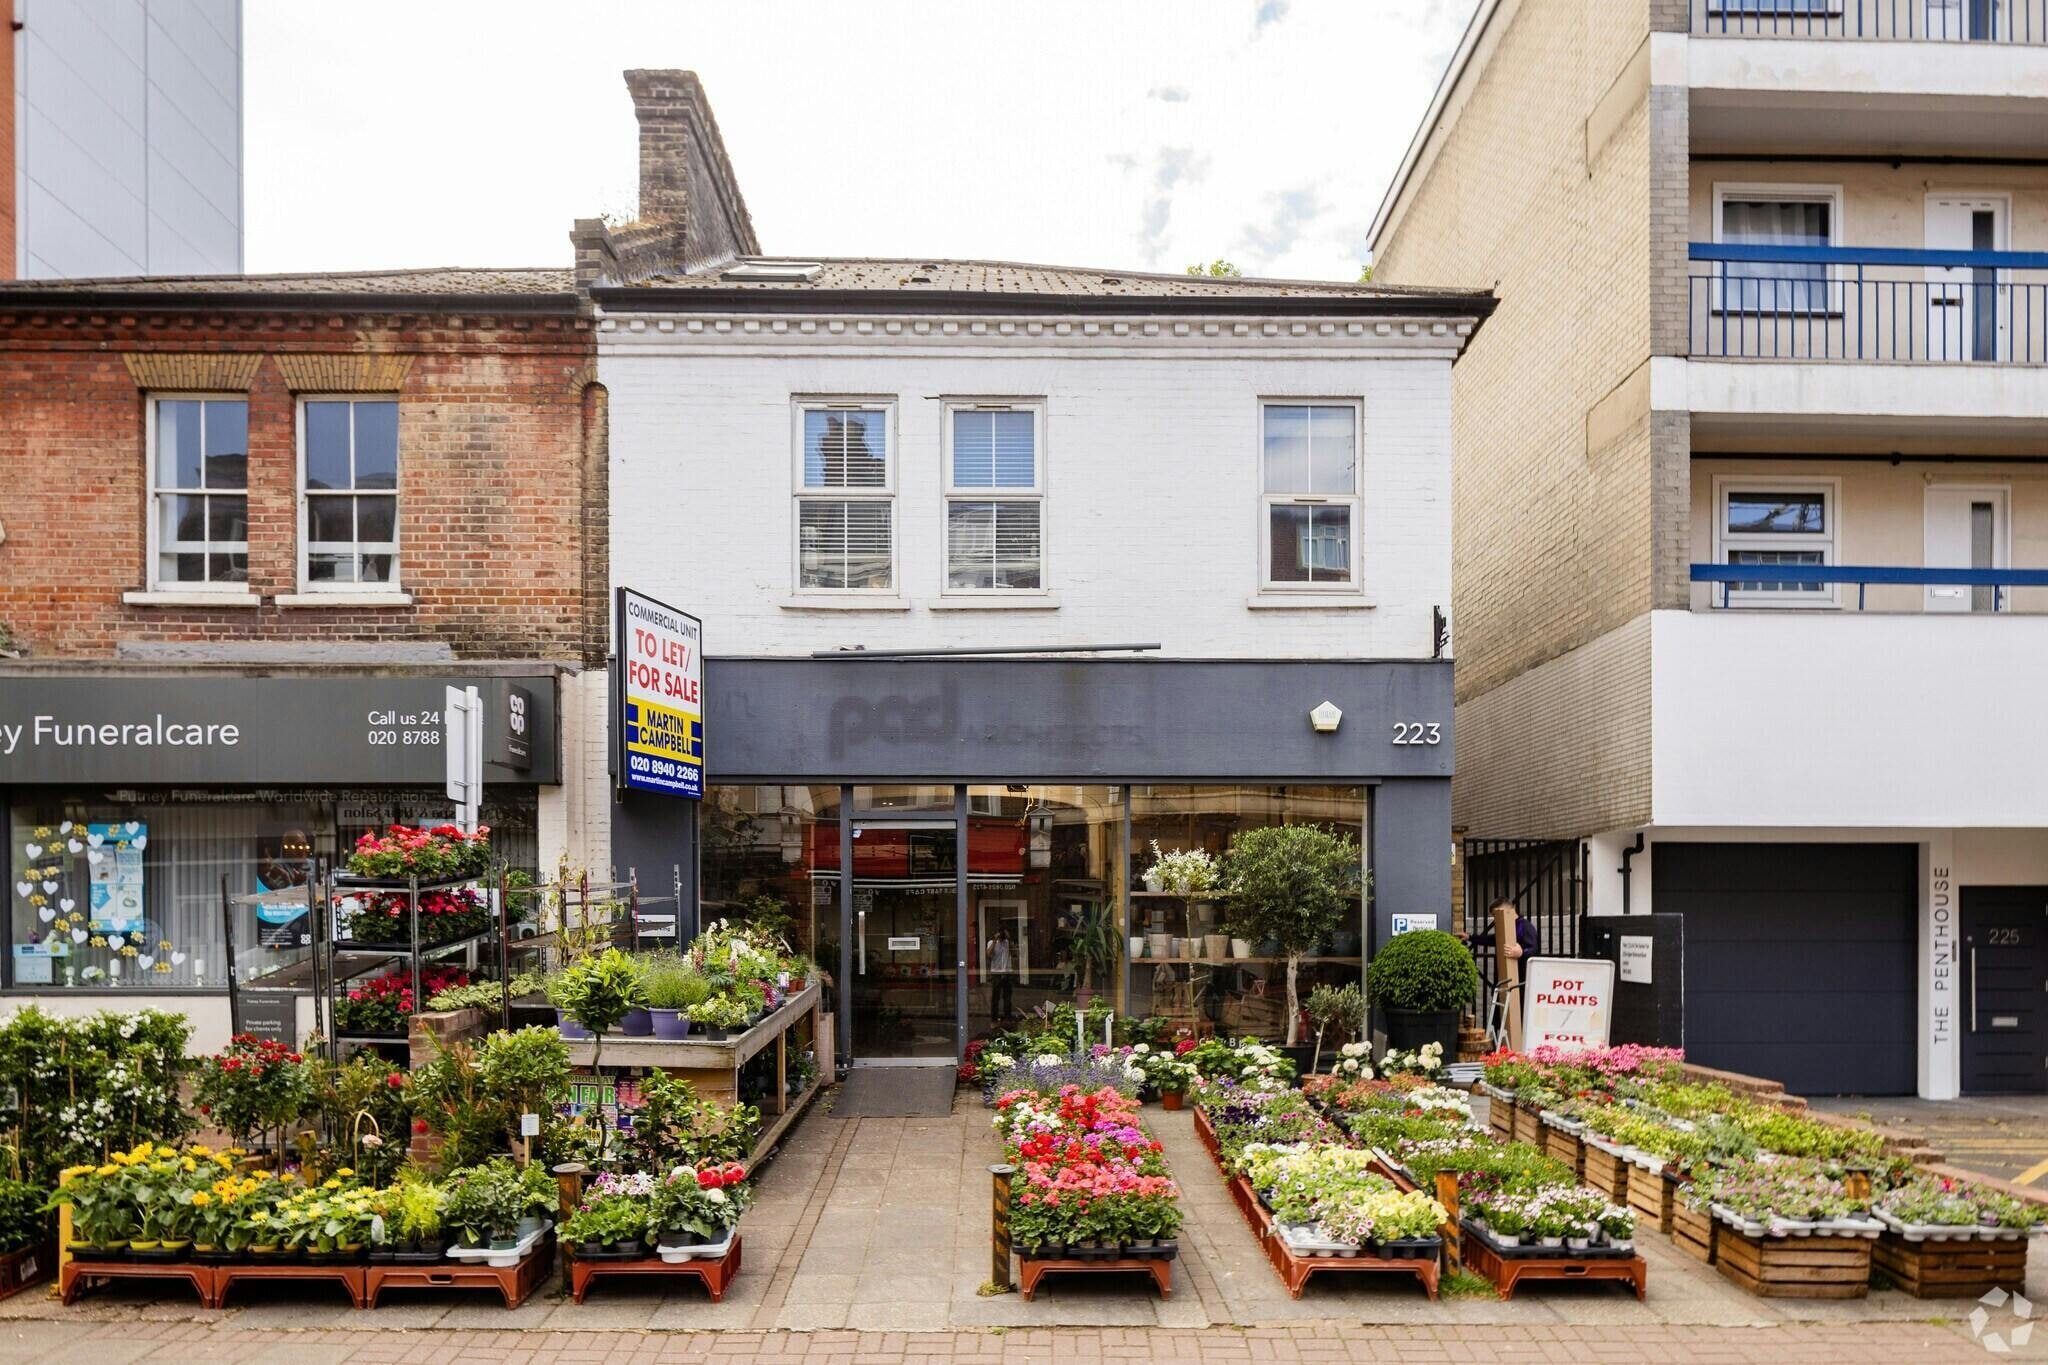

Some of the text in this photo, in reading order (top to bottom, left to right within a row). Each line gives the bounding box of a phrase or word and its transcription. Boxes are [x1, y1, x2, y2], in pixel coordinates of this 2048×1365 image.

[628, 602, 697, 640] COMMERCIAL UNIT
[635, 628, 691, 672] TO LET/
[629, 660, 698, 704] FOR SALE
[367, 711, 396, 726] Call
[400, 714, 417, 726] us
[420, 711, 441, 726] 24
[647, 708, 684, 735] MARTIN
[34, 714, 240, 746] Funeralcare
[367, 731, 397, 745] 020
[402, 731, 440, 745] 8788
[640, 726, 691, 755] CAMPBELL
[1392, 722, 1441, 745] 223
[631, 755, 699, 782] 020 8940 2266
[631, 773, 698, 792] www.martincampbell.co.uk
[1988, 928, 2020, 945] 225
[1934, 866, 1949, 1044] THE PENTHOUSE
[1552, 979, 1585, 991] POT
[1537, 994, 1598, 1007] PLANTS
[262, 1019, 282, 1027] parking
[1544, 1033, 1585, 1043] FOR
[580, 1085, 616, 1104] FAR
